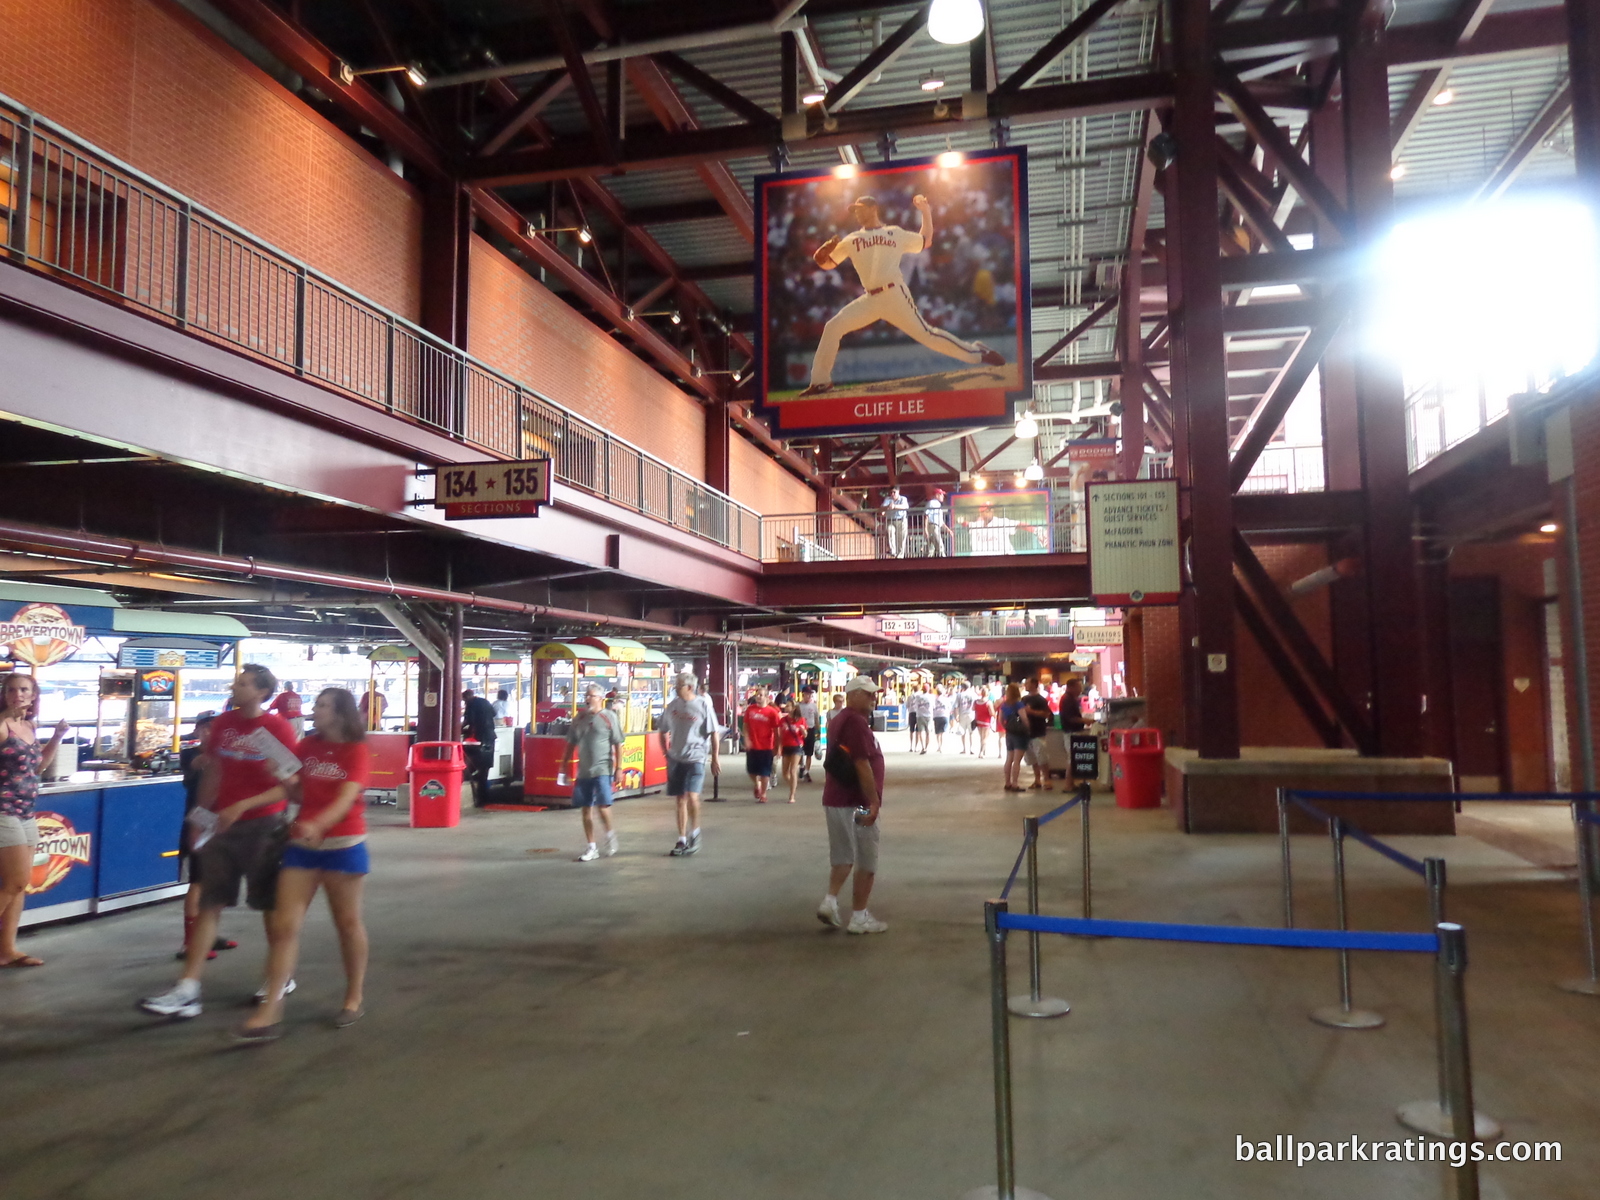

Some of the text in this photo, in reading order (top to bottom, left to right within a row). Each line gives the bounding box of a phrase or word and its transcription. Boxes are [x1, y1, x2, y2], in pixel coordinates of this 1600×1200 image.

[852, 235, 897, 252] Phillies
[854, 400, 925, 417] CLIFF LEE
[444, 467, 539, 498] 134 135
[1103, 492, 1135, 501] SECTIONS
[461, 503, 521, 514] SECTIONS
[1103, 506, 1133, 514] ADVANCE
[1103, 515, 1124, 523] GUEST
[0, 624, 83, 645] BREWERYTOWN
[1076, 763, 1094, 771] HERE
[36, 835, 89, 857] RYTOWN
